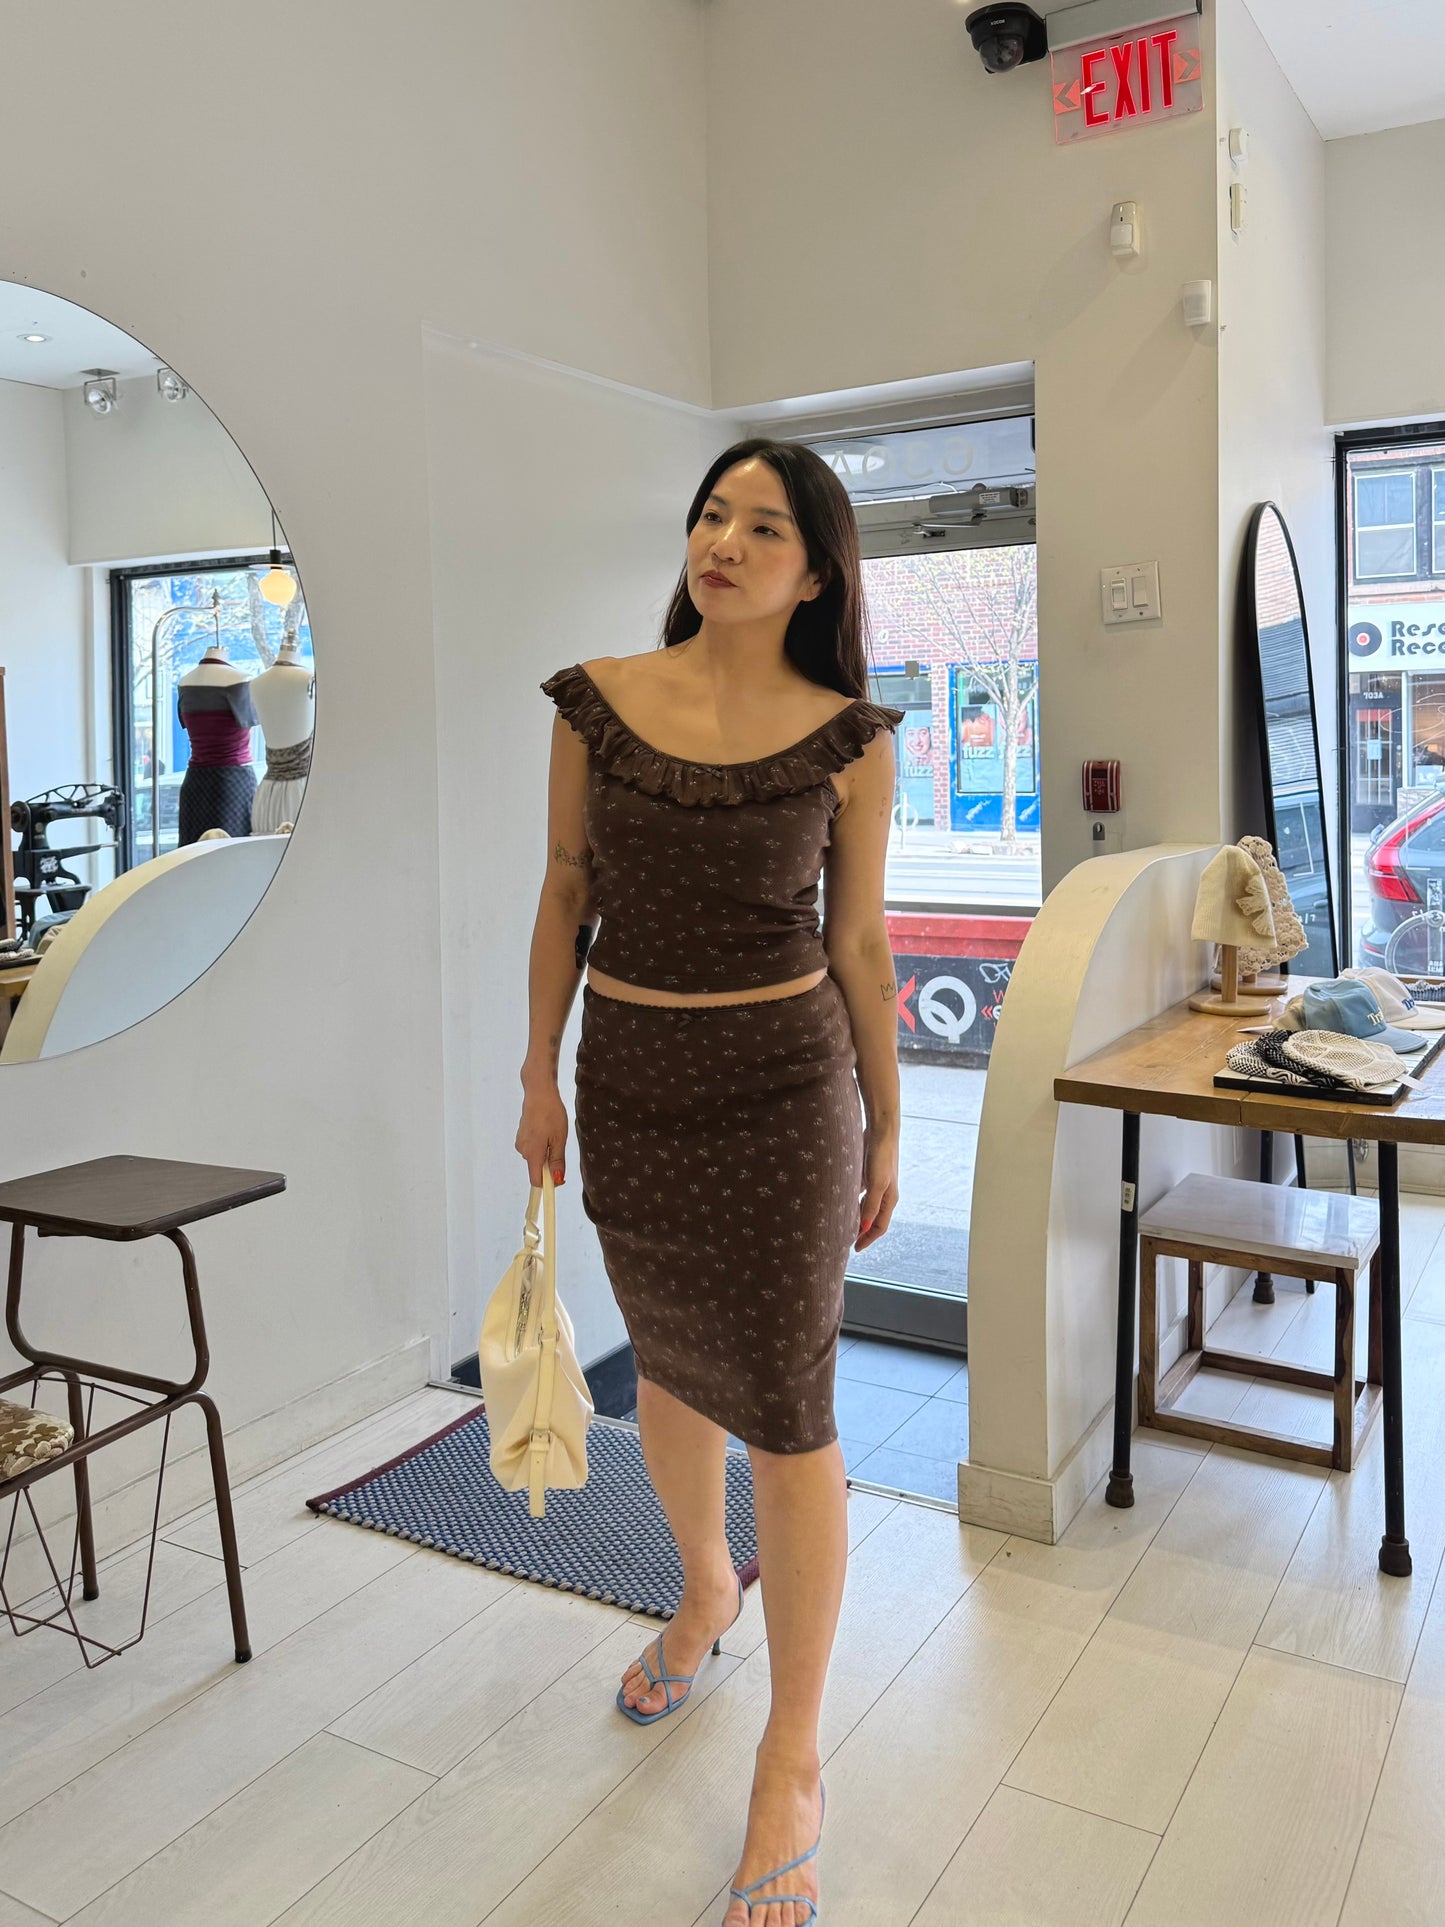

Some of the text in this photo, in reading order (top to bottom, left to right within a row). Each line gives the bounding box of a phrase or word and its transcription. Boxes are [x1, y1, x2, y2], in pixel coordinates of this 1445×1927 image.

[1081, 29, 1178, 128] EXIT
[962, 742, 995, 759] fuzz
[998, 741, 1032, 759] fzz
[904, 761, 933, 777] fuzz
